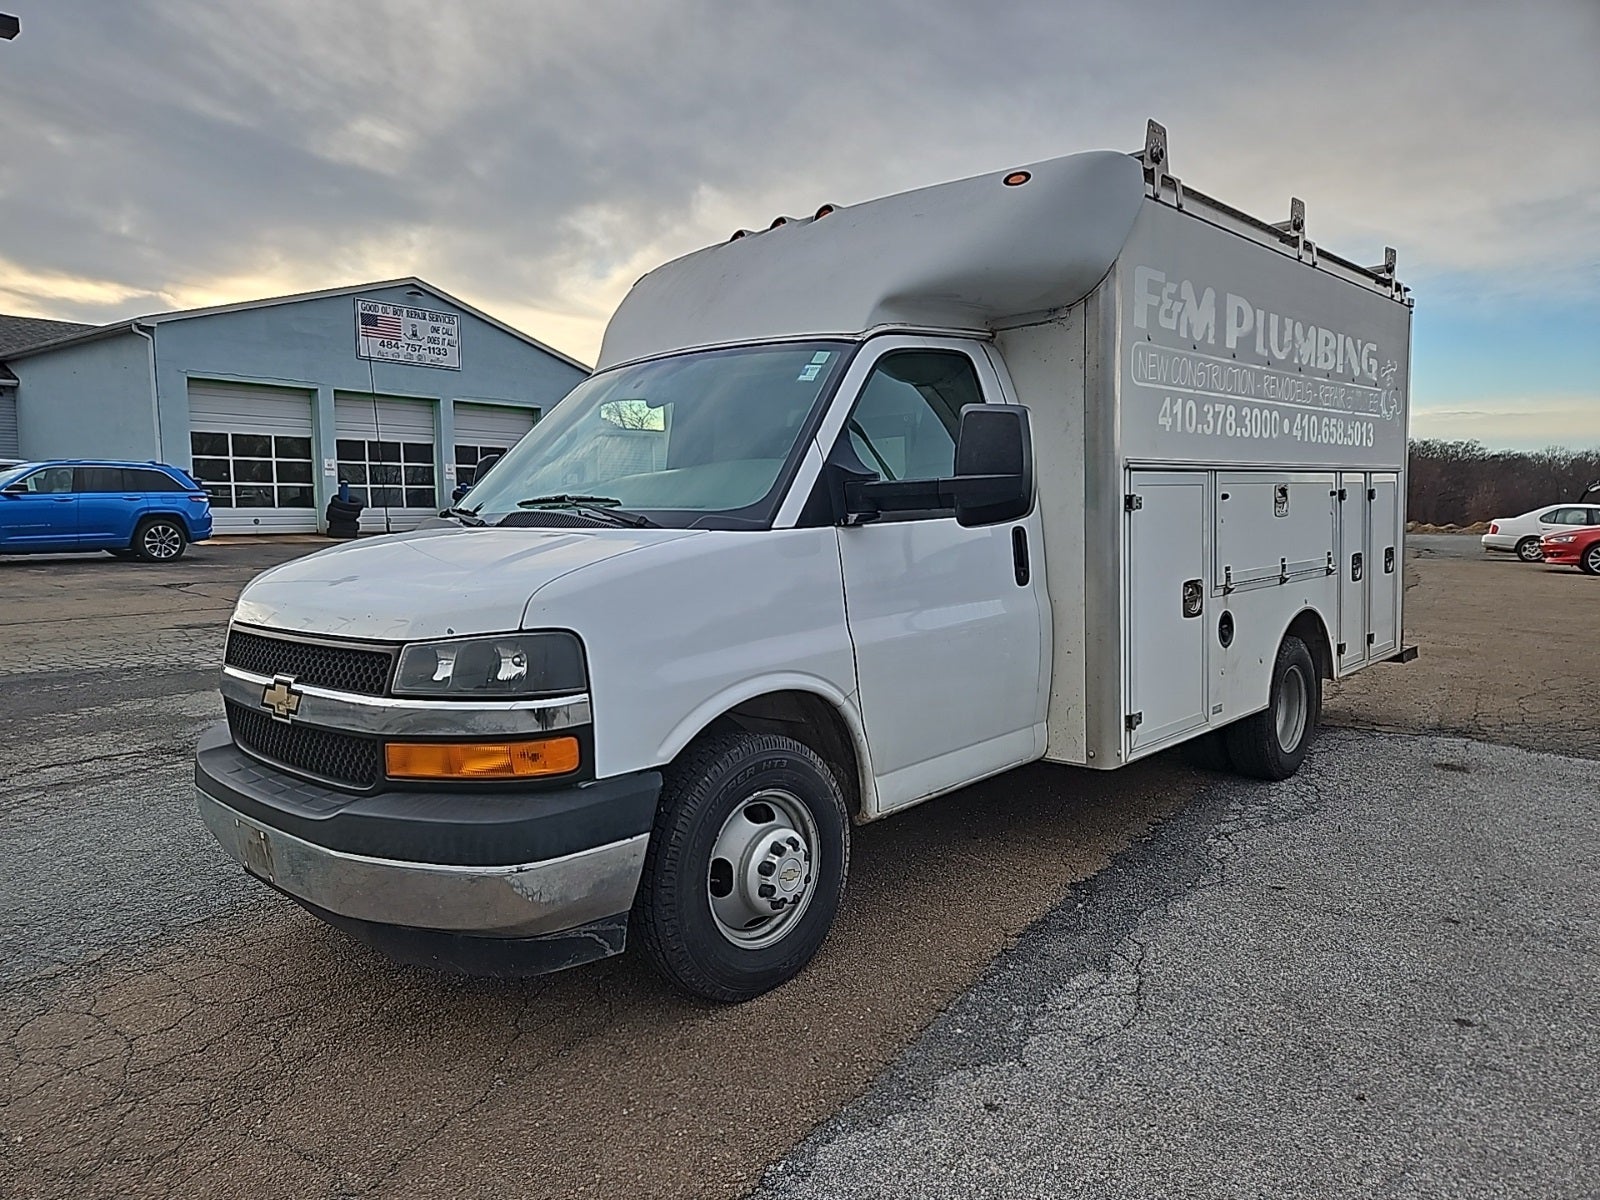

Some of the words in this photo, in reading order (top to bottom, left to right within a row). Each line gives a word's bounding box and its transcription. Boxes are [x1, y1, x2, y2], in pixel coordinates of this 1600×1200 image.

[361, 302, 379, 313] GOOD
[393, 307, 404, 317] BOY
[406, 310, 427, 321] REPAIR
[428, 312, 456, 325] SERVICES
[1133, 265, 1216, 345] F&M
[1225, 292, 1378, 381] PLUMBING
[427, 336, 440, 346] DOES
[430, 325, 440, 335] ONE
[441, 326, 453, 336] CALL
[379, 340, 448, 357] 484-757-1133
[1137, 351, 1170, 382] NEW
[1171, 356, 1255, 396] CONSTRUCTION
[1263, 374, 1313, 405] REMODELS
[1158, 397, 1280, 439] 410.378.3000
[1292, 412, 1374, 447] 410.658.5013
